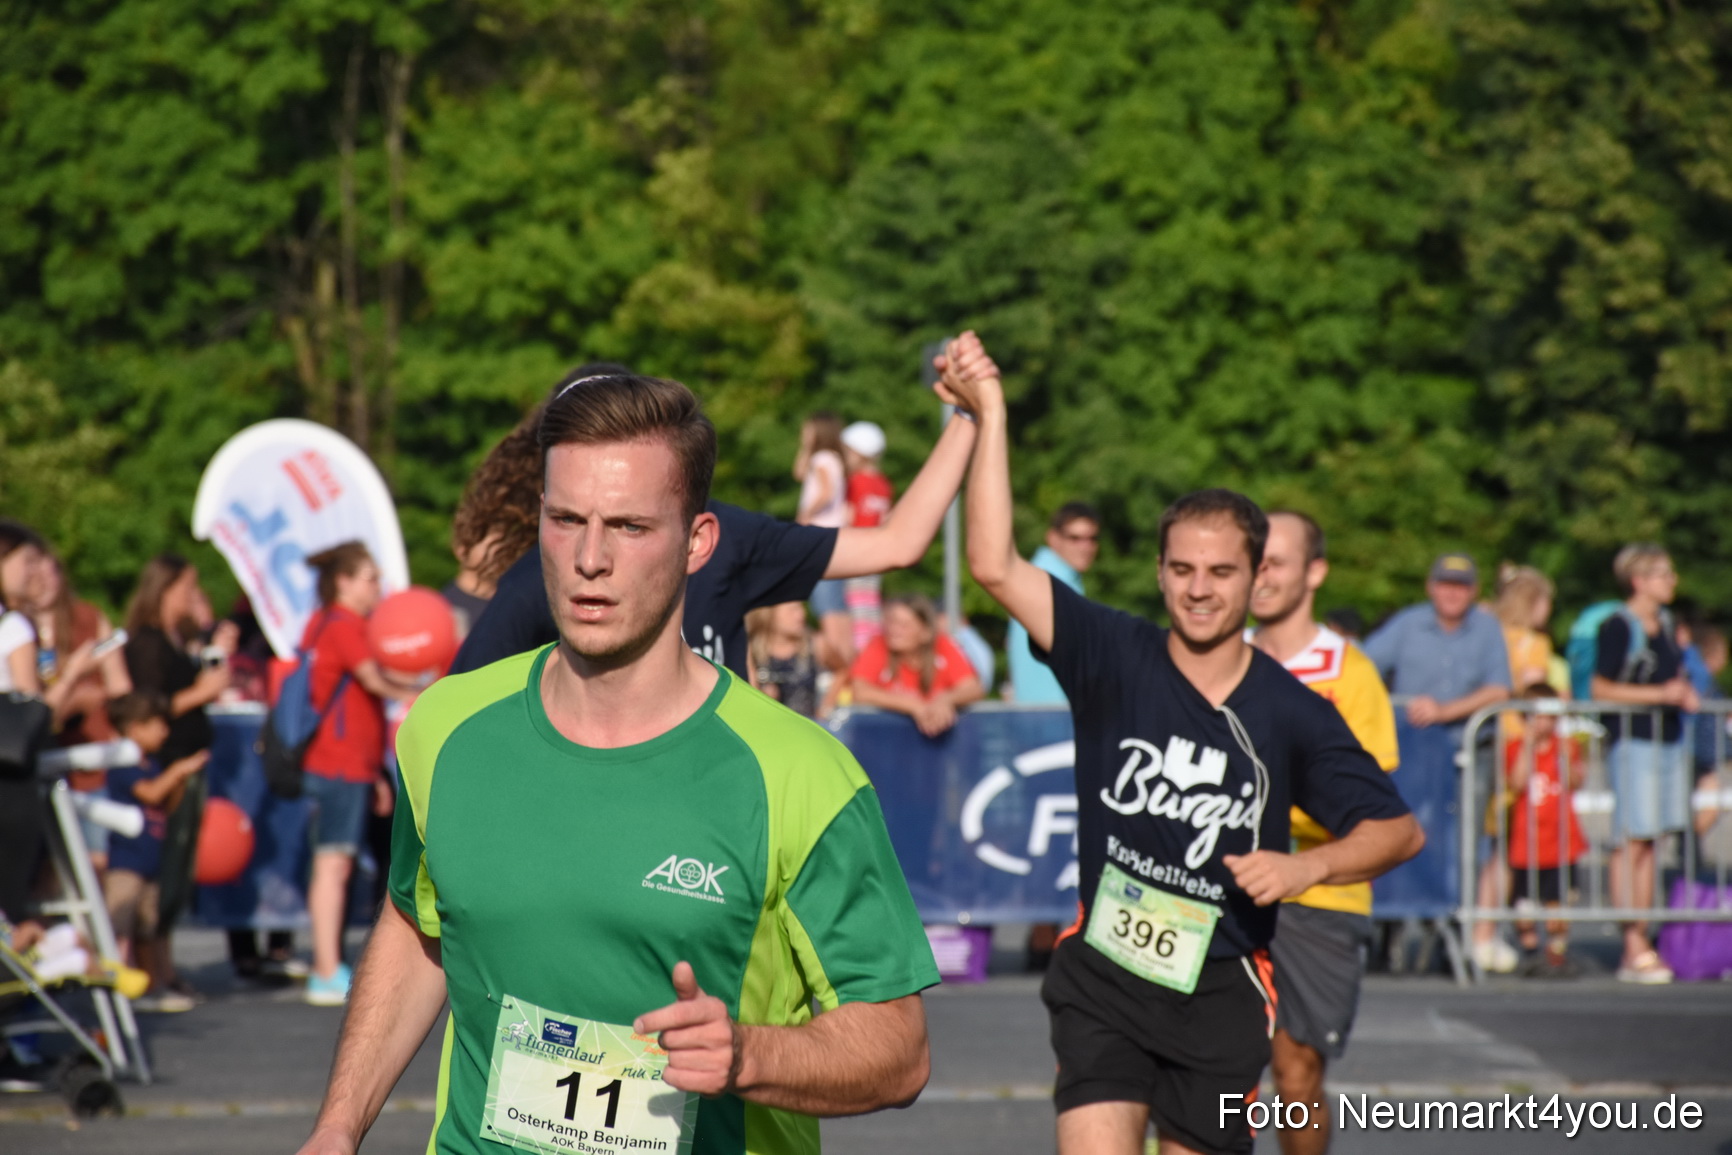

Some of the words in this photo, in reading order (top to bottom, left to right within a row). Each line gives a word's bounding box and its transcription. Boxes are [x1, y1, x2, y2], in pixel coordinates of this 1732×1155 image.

[641, 879, 655, 889] Die
[656, 882, 726, 904] Gesundheitskasse.
[645, 855, 729, 896] AOK
[1113, 909, 1178, 958] 396
[525, 1034, 607, 1065] firmenlauf
[621, 1067, 647, 1079] run
[556, 1071, 622, 1128] 11
[507, 1107, 589, 1140] Osterkamp
[594, 1130, 668, 1151] Benjamin
[551, 1135, 575, 1149] AOK
[577, 1142, 615, 1155] Bayern
